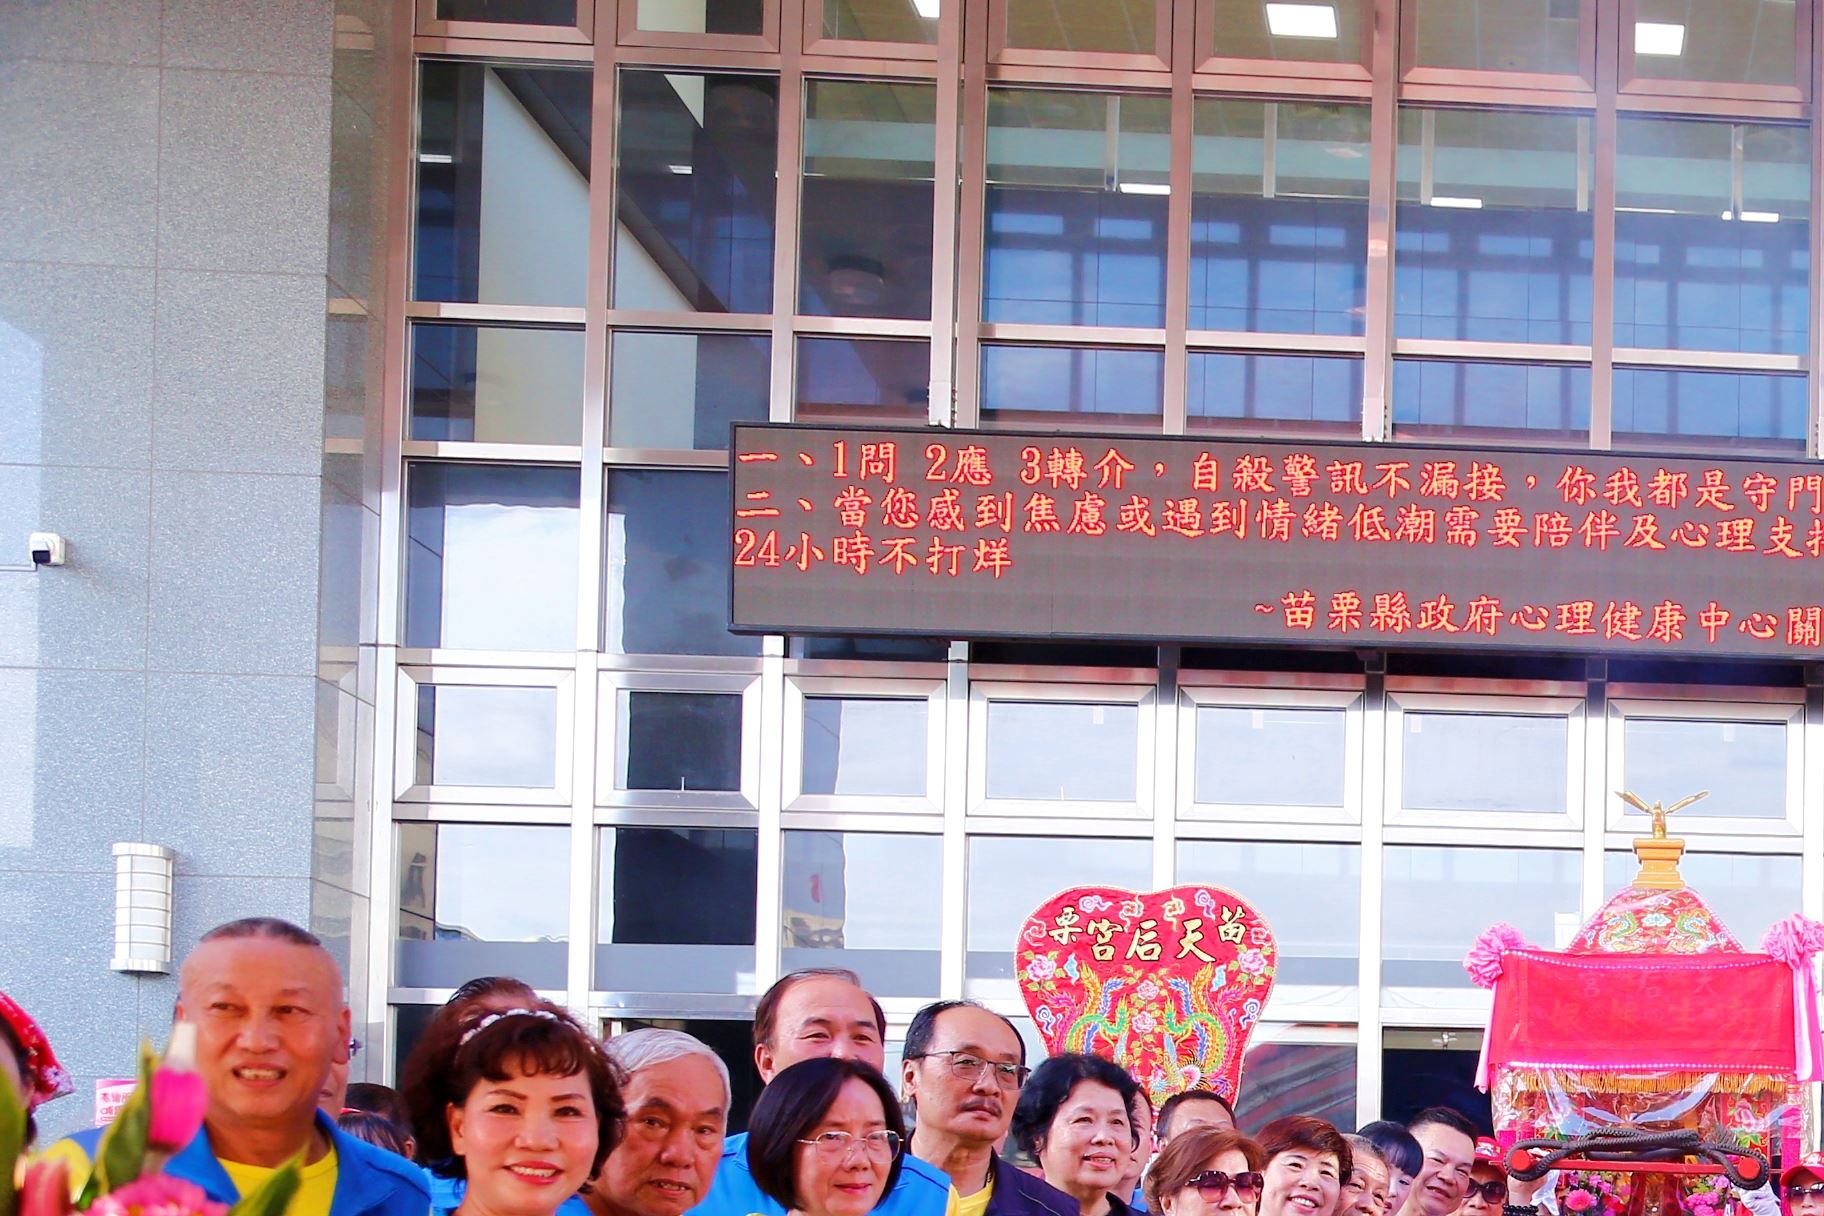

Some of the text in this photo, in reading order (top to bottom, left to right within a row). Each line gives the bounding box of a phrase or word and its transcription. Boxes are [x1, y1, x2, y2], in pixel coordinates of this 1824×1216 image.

[738, 442, 898, 483] 一、1問
[924, 443, 993, 487] 2應
[734, 528, 1013, 578] 24小時不打烊
